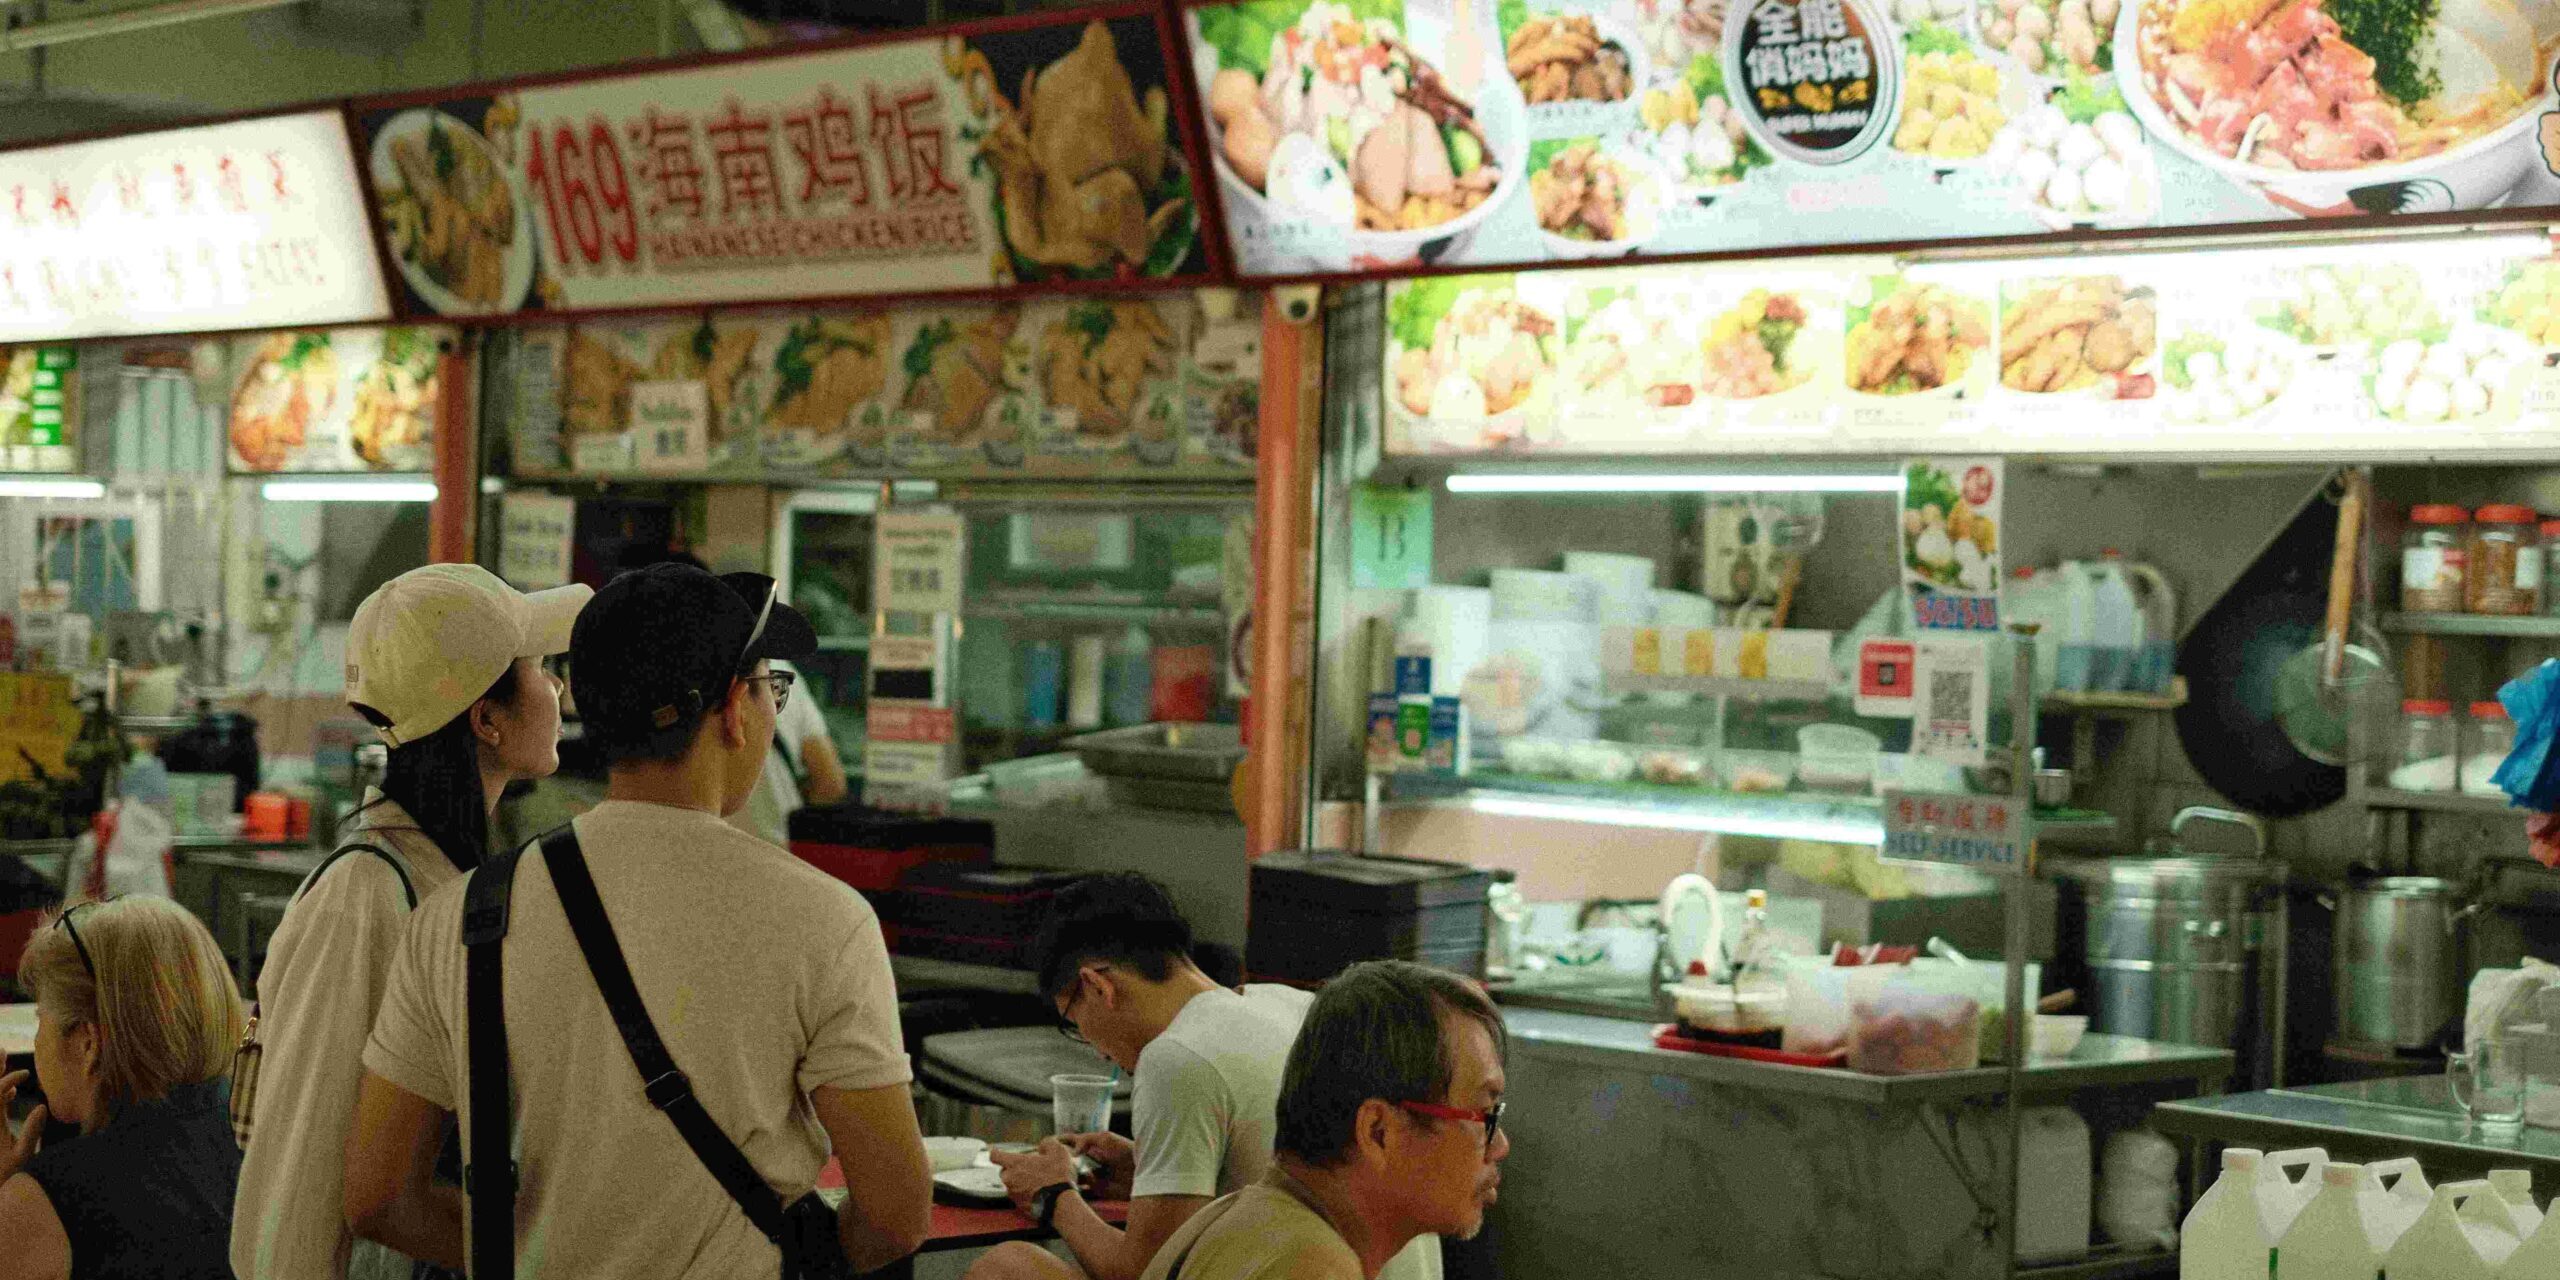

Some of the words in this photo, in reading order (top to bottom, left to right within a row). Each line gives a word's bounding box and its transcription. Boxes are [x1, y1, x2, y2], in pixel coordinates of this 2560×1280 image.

[526, 118, 638, 264] 169
[630, 86, 960, 218] 海南鸡饭
[652, 219, 791, 258] HAINANESE
[794, 210, 907, 250] CHICKEN
[909, 204, 976, 246] RICE
